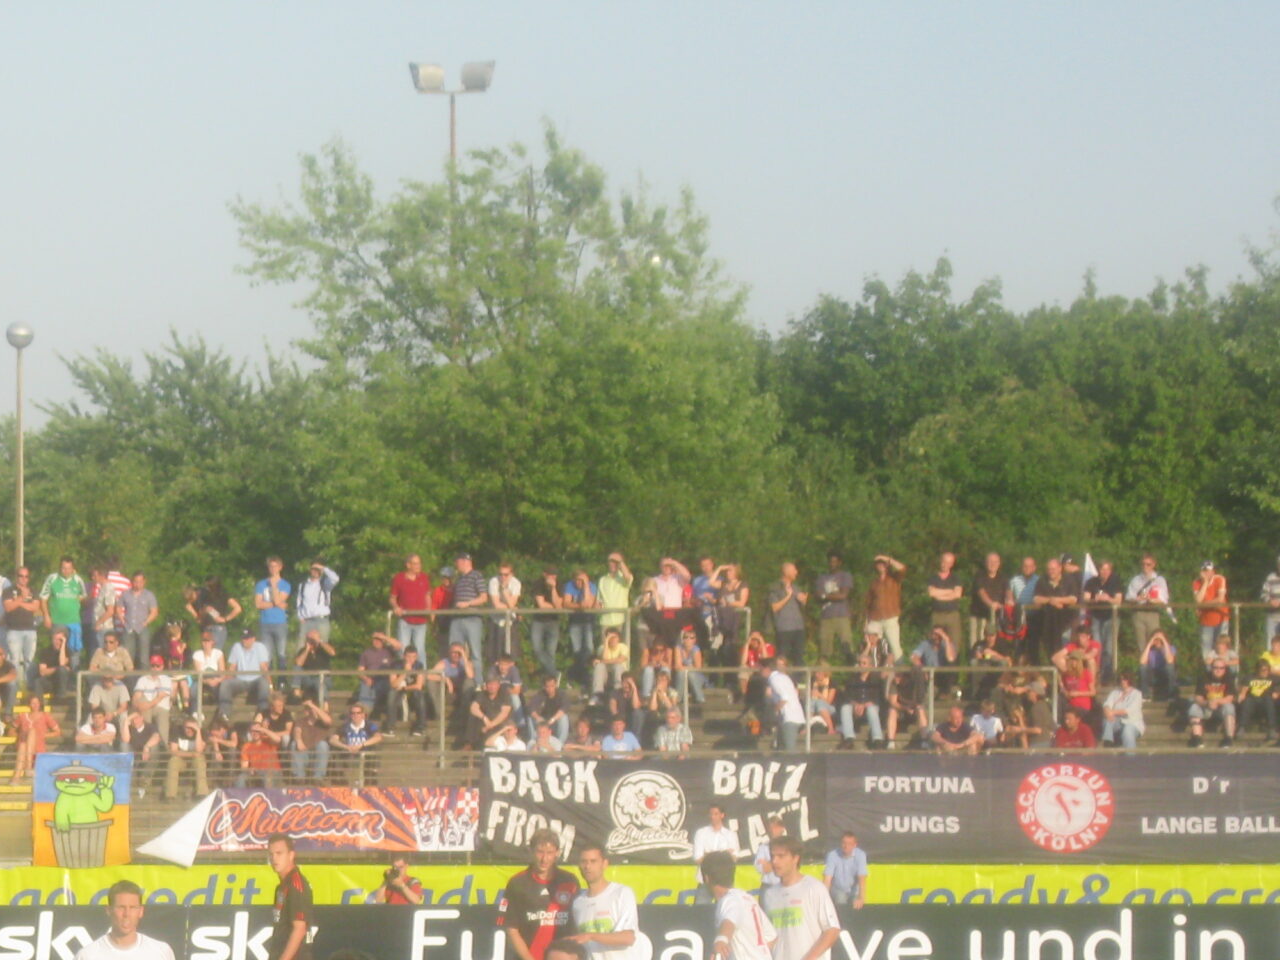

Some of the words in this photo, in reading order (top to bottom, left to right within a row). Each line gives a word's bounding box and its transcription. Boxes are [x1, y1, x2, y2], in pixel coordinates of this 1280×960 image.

[488, 757, 601, 803] BACK
[712, 760, 808, 801] BOLZ
[864, 775, 975, 793] FORTUNA
[486, 801, 576, 862] FROM
[880, 816, 961, 834] JUNGS
[1141, 816, 1218, 834] LANGE
[1225, 816, 1280, 834] BALL
[1033, 828, 1097, 850] KÖLN
